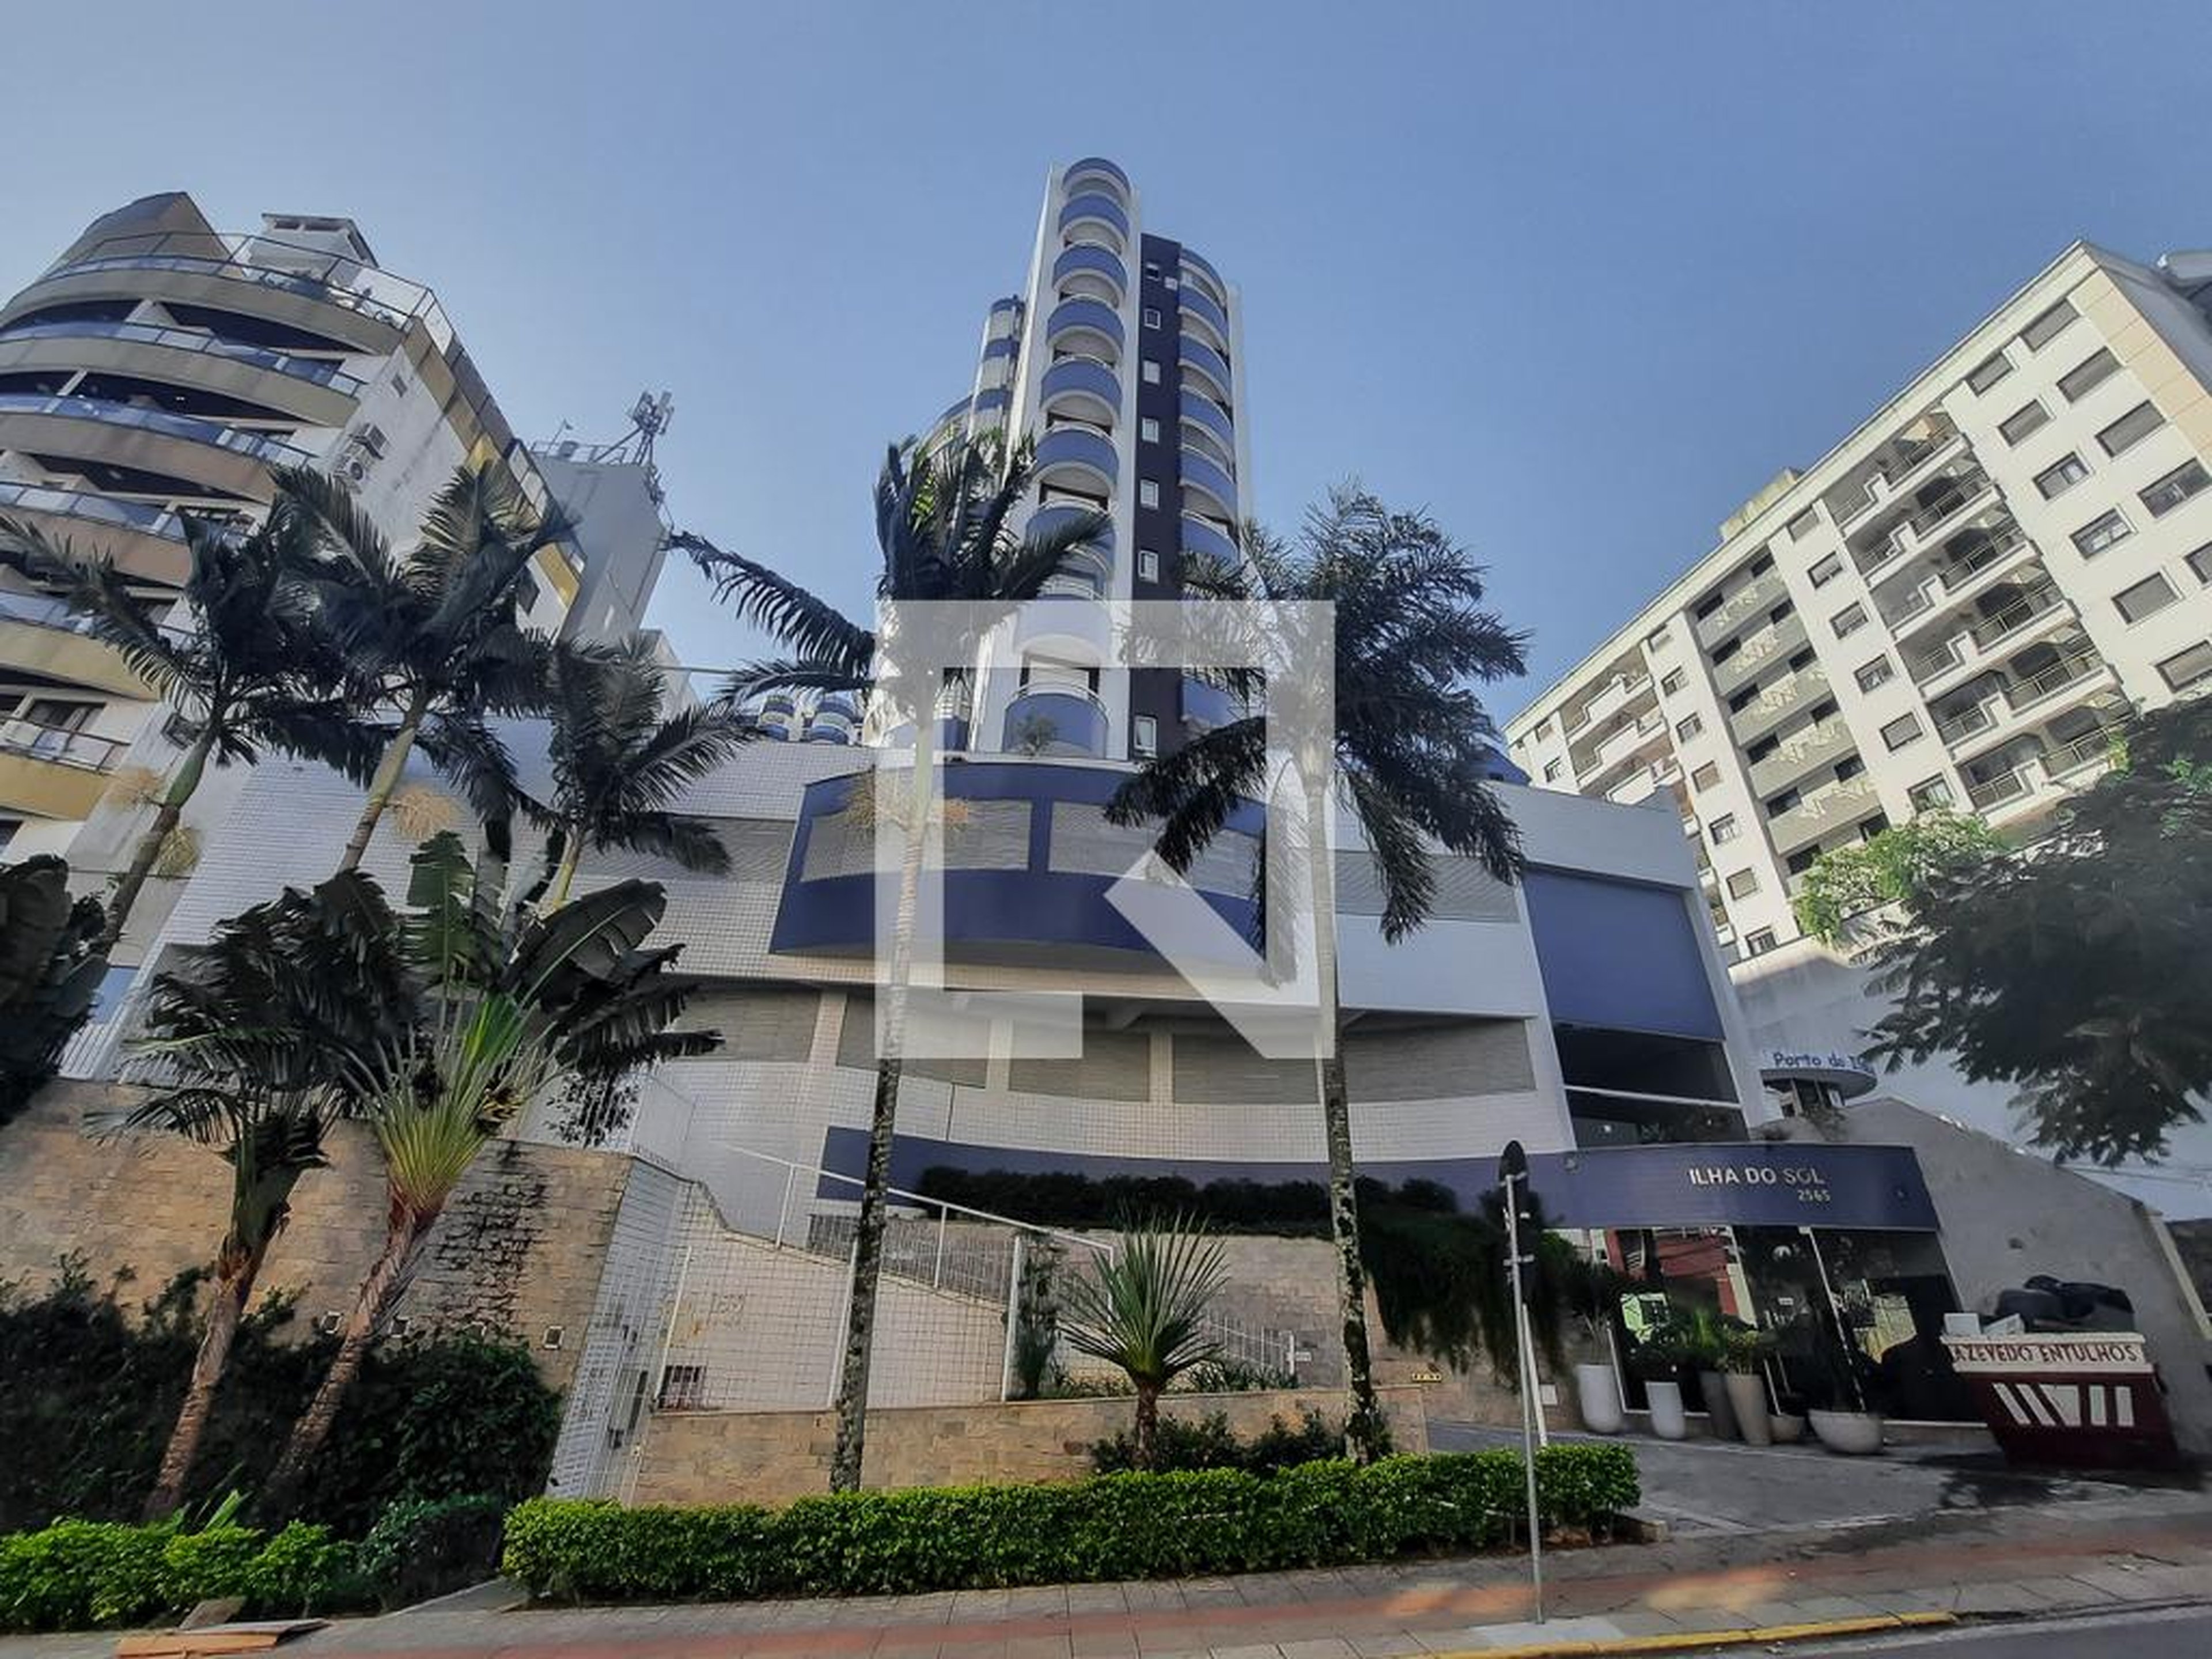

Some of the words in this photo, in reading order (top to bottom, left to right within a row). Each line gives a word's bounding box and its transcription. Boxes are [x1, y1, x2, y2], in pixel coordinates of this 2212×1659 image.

[1773, 1051, 1822, 1066] Porto
[1688, 1167, 1740, 1184] ILHA
[1745, 1167, 1777, 1184] DO
[1783, 1168, 1825, 1185] SOL
[1797, 1188, 1831, 1202] 2565
[1953, 1344, 2034, 1362] AZEVEDO
[2038, 1343, 2138, 1362] ENTULHOS
